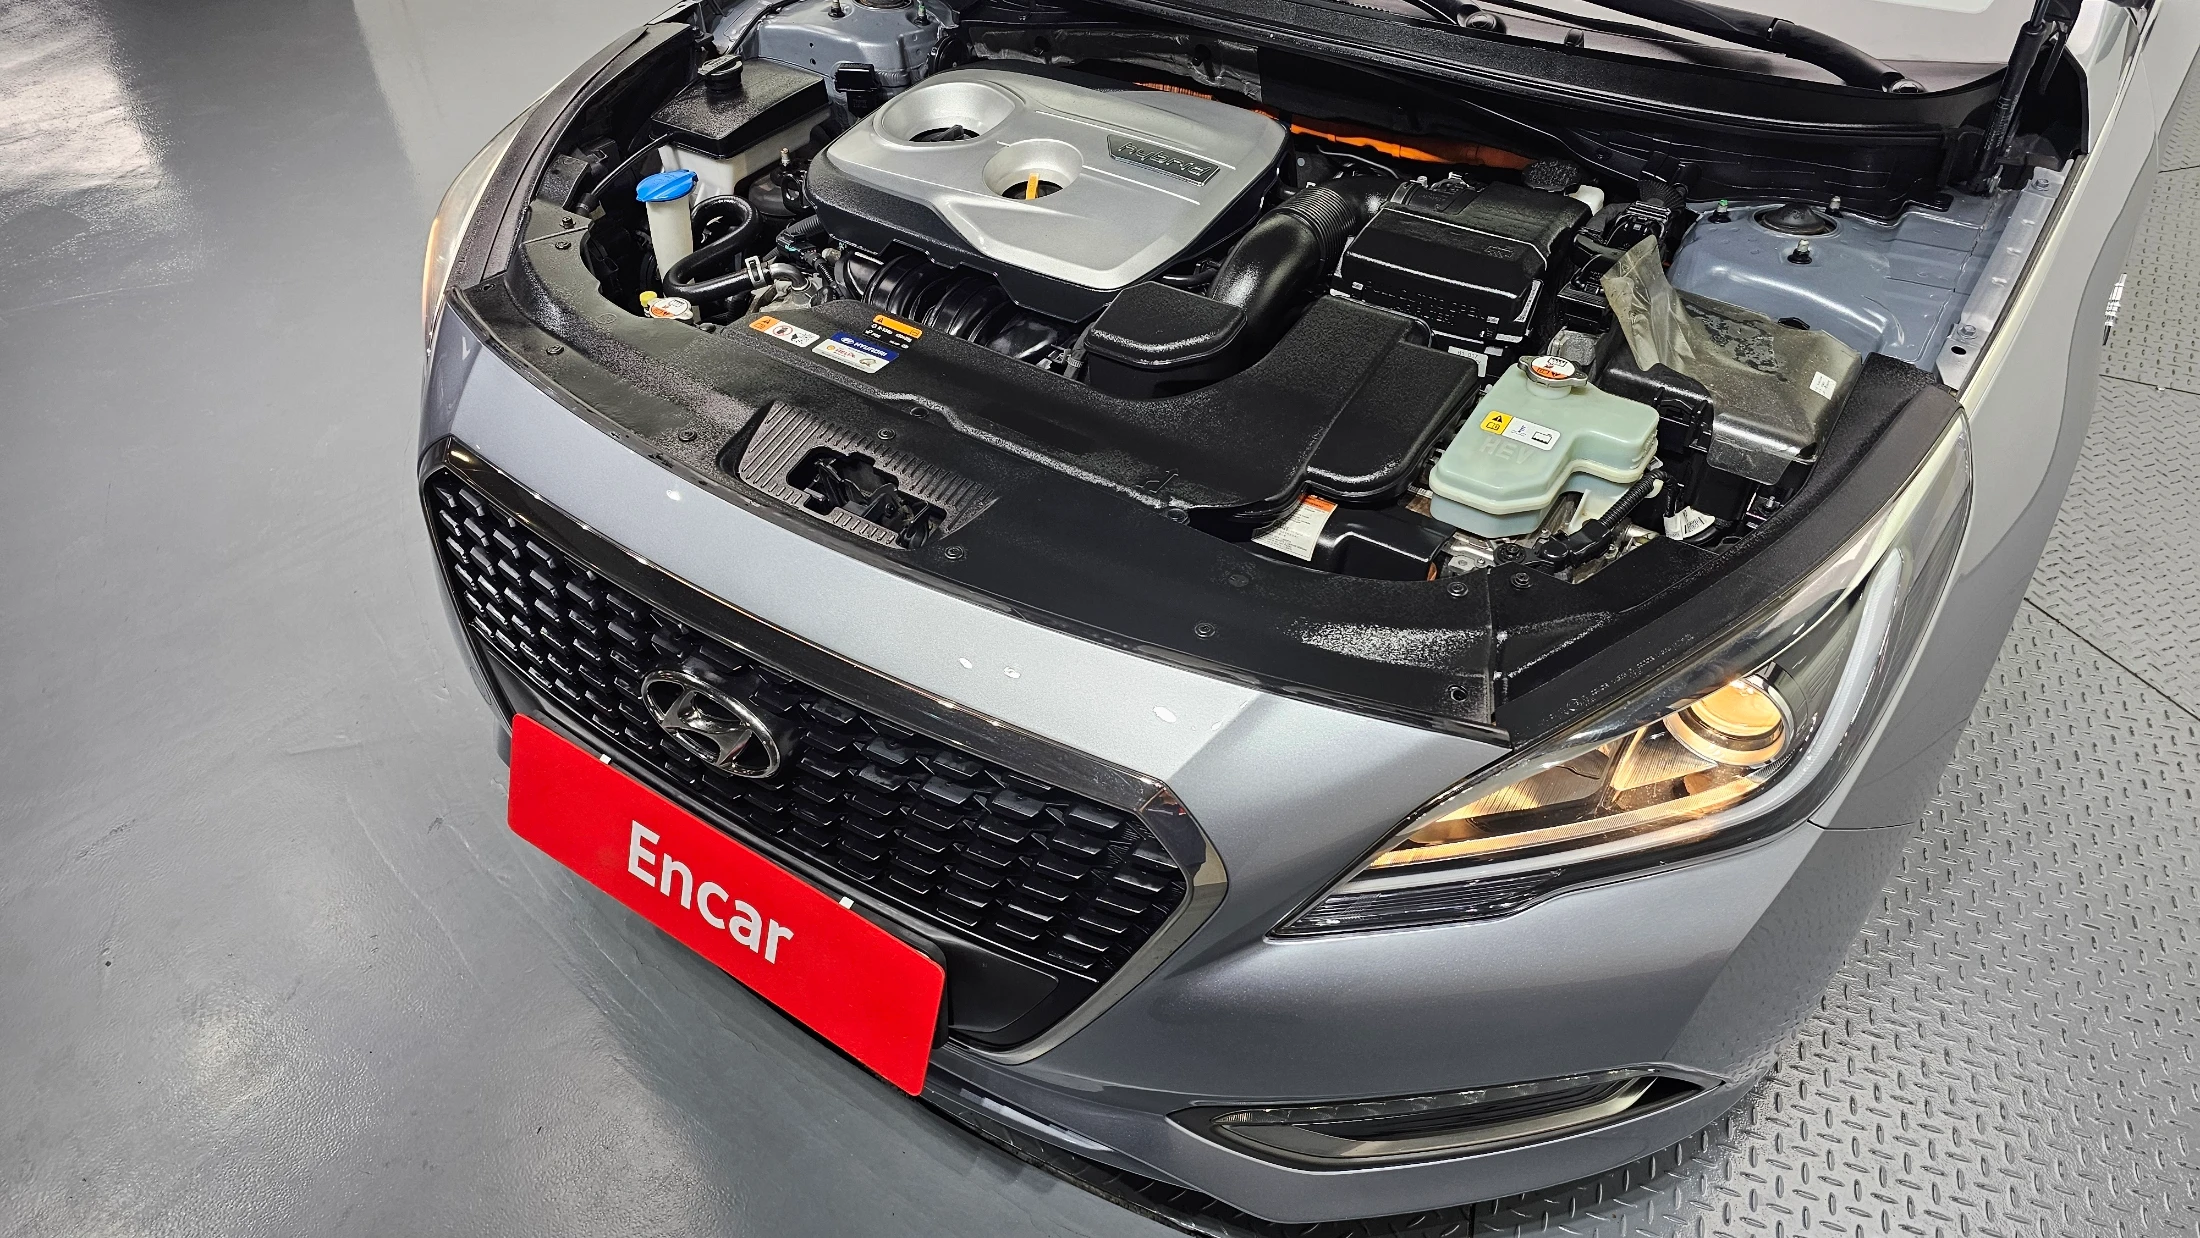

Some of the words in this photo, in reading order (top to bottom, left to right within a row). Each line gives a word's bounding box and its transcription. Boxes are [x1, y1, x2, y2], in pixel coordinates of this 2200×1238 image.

[1118, 141, 1212, 176] hybrid
[854, 341, 888, 358] HYUNDAI
[1481, 436, 1536, 464] HEV
[627, 820, 795, 964] Encar
